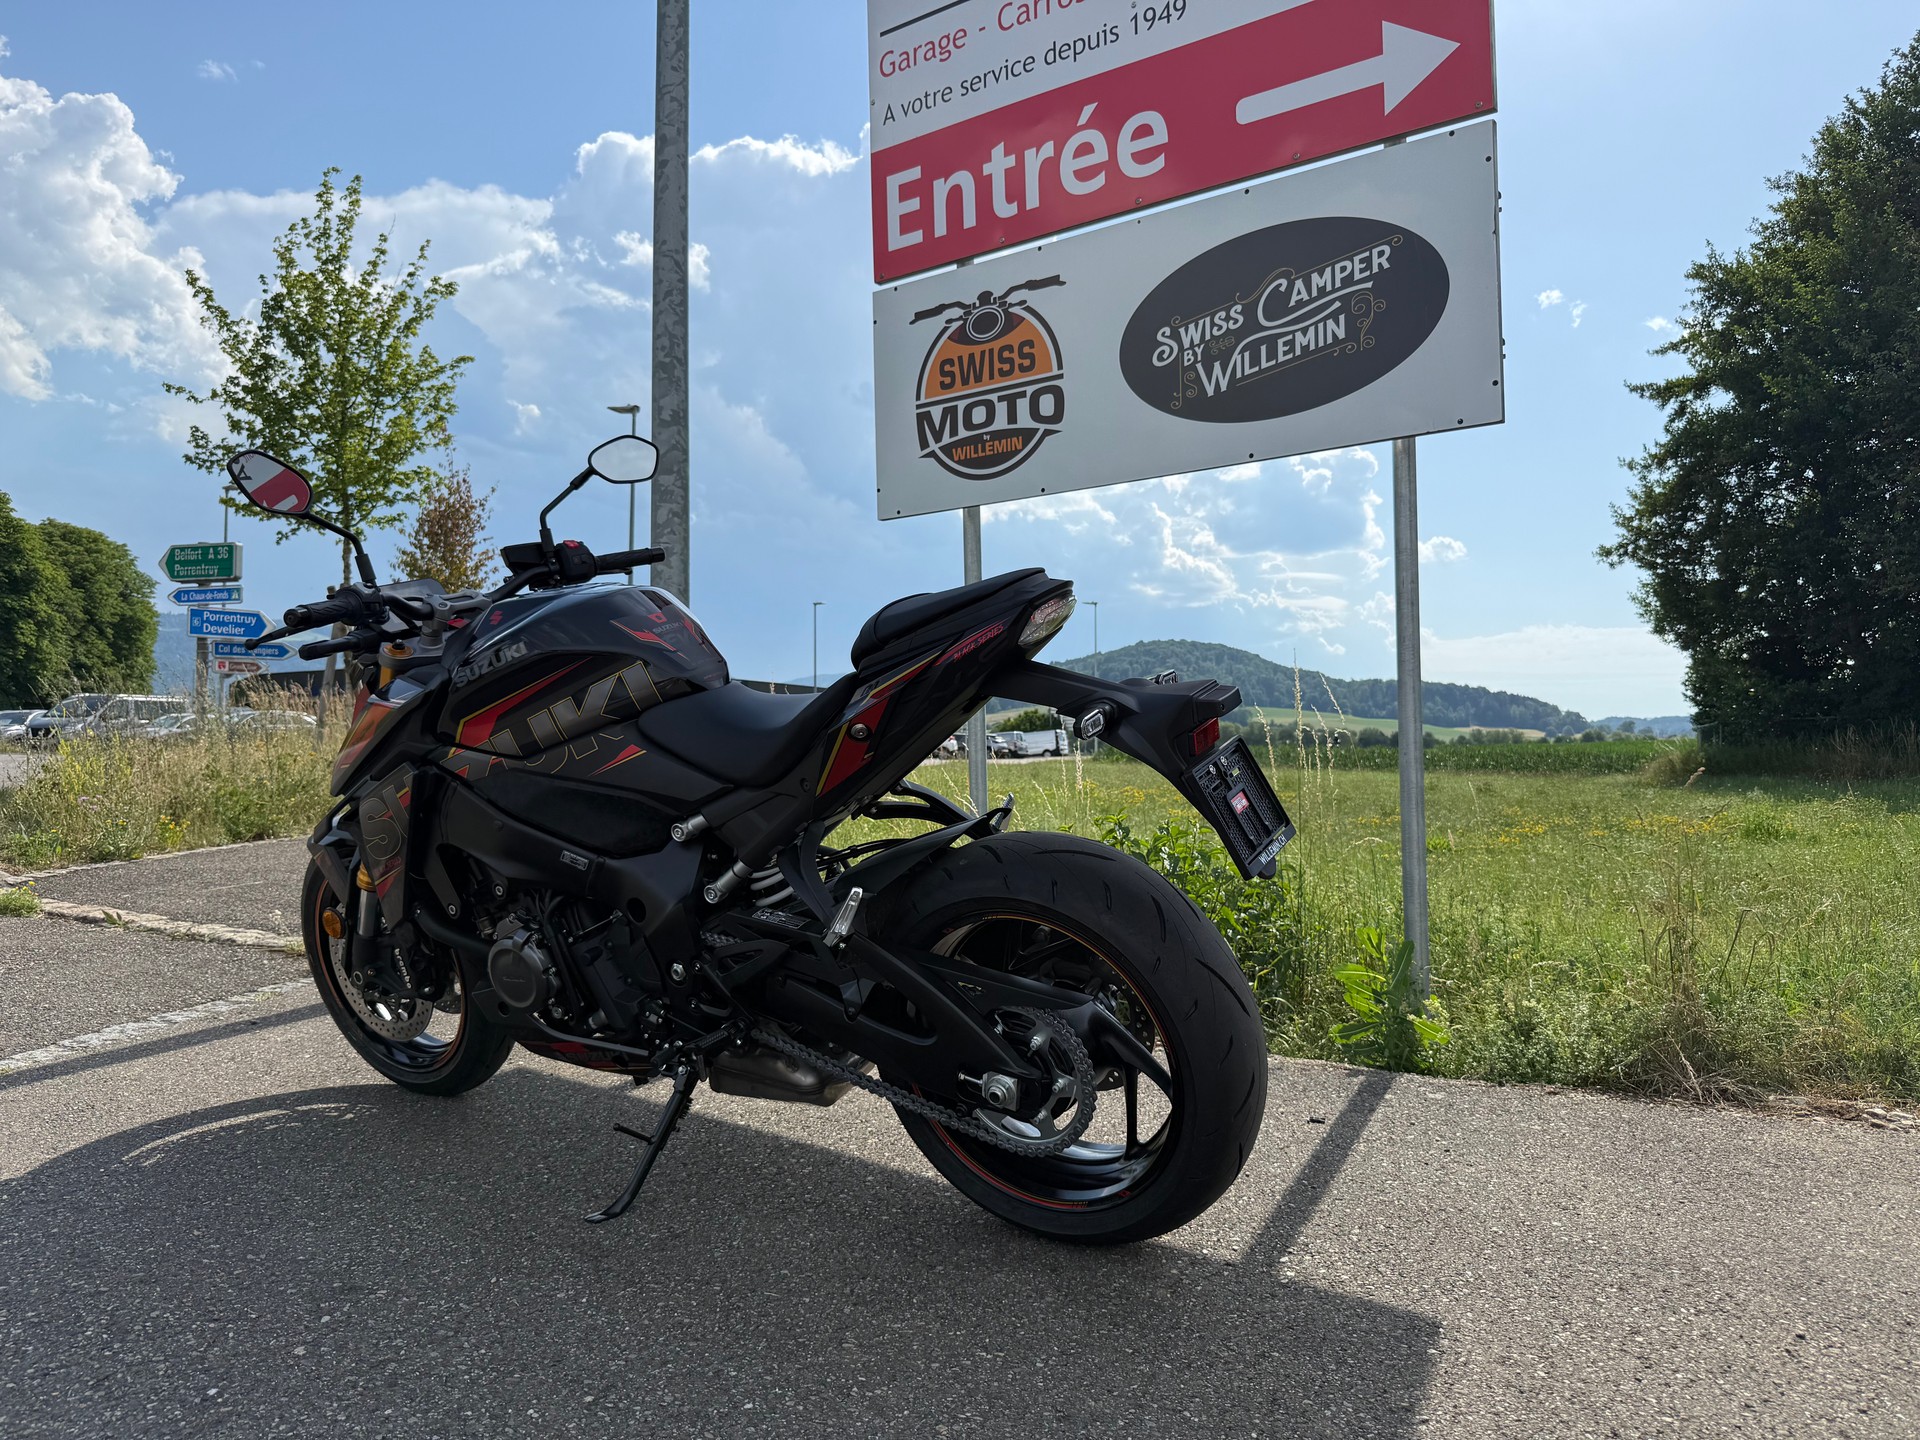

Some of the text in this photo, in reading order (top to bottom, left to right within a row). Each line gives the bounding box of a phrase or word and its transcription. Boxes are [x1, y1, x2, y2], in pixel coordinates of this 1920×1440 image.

[879, 28, 968, 78] Garage
[882, 0, 1187, 126] A votre service depuis 1949
[886, 101, 1169, 253] Entrée
[1152, 244, 1391, 367] SWISS CAMPER
[939, 339, 1036, 390] SWISS
[1183, 343, 1205, 367] BY
[1195, 301, 1346, 398] WILLEMIN
[916, 384, 1065, 452] MOTO
[952, 436, 1023, 461] WILLEMIN
[174, 546, 229, 561] Belfort A 36
[174, 564, 219, 576] Porrentruy
[203, 611, 257, 627] Porrentruy
[203, 623, 245, 635] Develier
[218, 644, 279, 657] Col des angiers
[455, 641, 529, 688] SUZUKI
